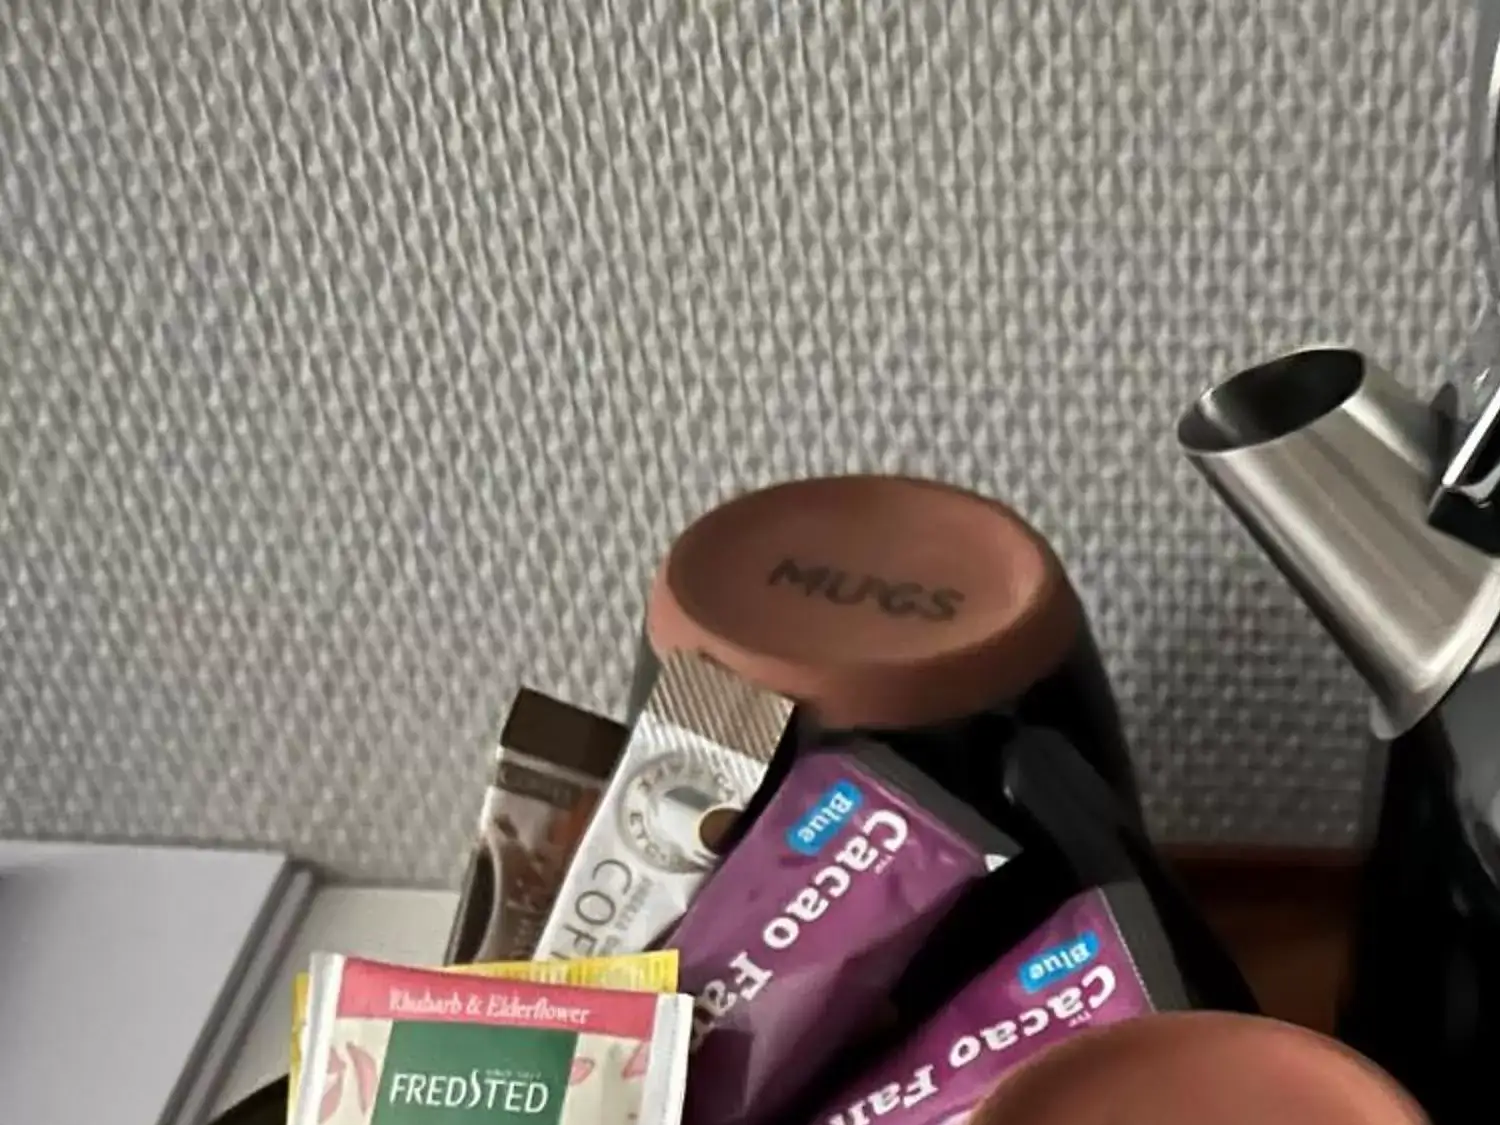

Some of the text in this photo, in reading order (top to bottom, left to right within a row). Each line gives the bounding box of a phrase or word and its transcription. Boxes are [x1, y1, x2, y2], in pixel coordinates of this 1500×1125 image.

[767, 558, 965, 622] MUGS
[797, 791, 853, 843] Blue
[762, 810, 909, 948] Cacao
[552, 858, 633, 959] COF
[1029, 942, 1091, 980] Blue
[389, 987, 590, 1025] Rhubarb & Elderflower
[948, 965, 1116, 1068] Cacao
[389, 1067, 549, 1114] FREDSTED
